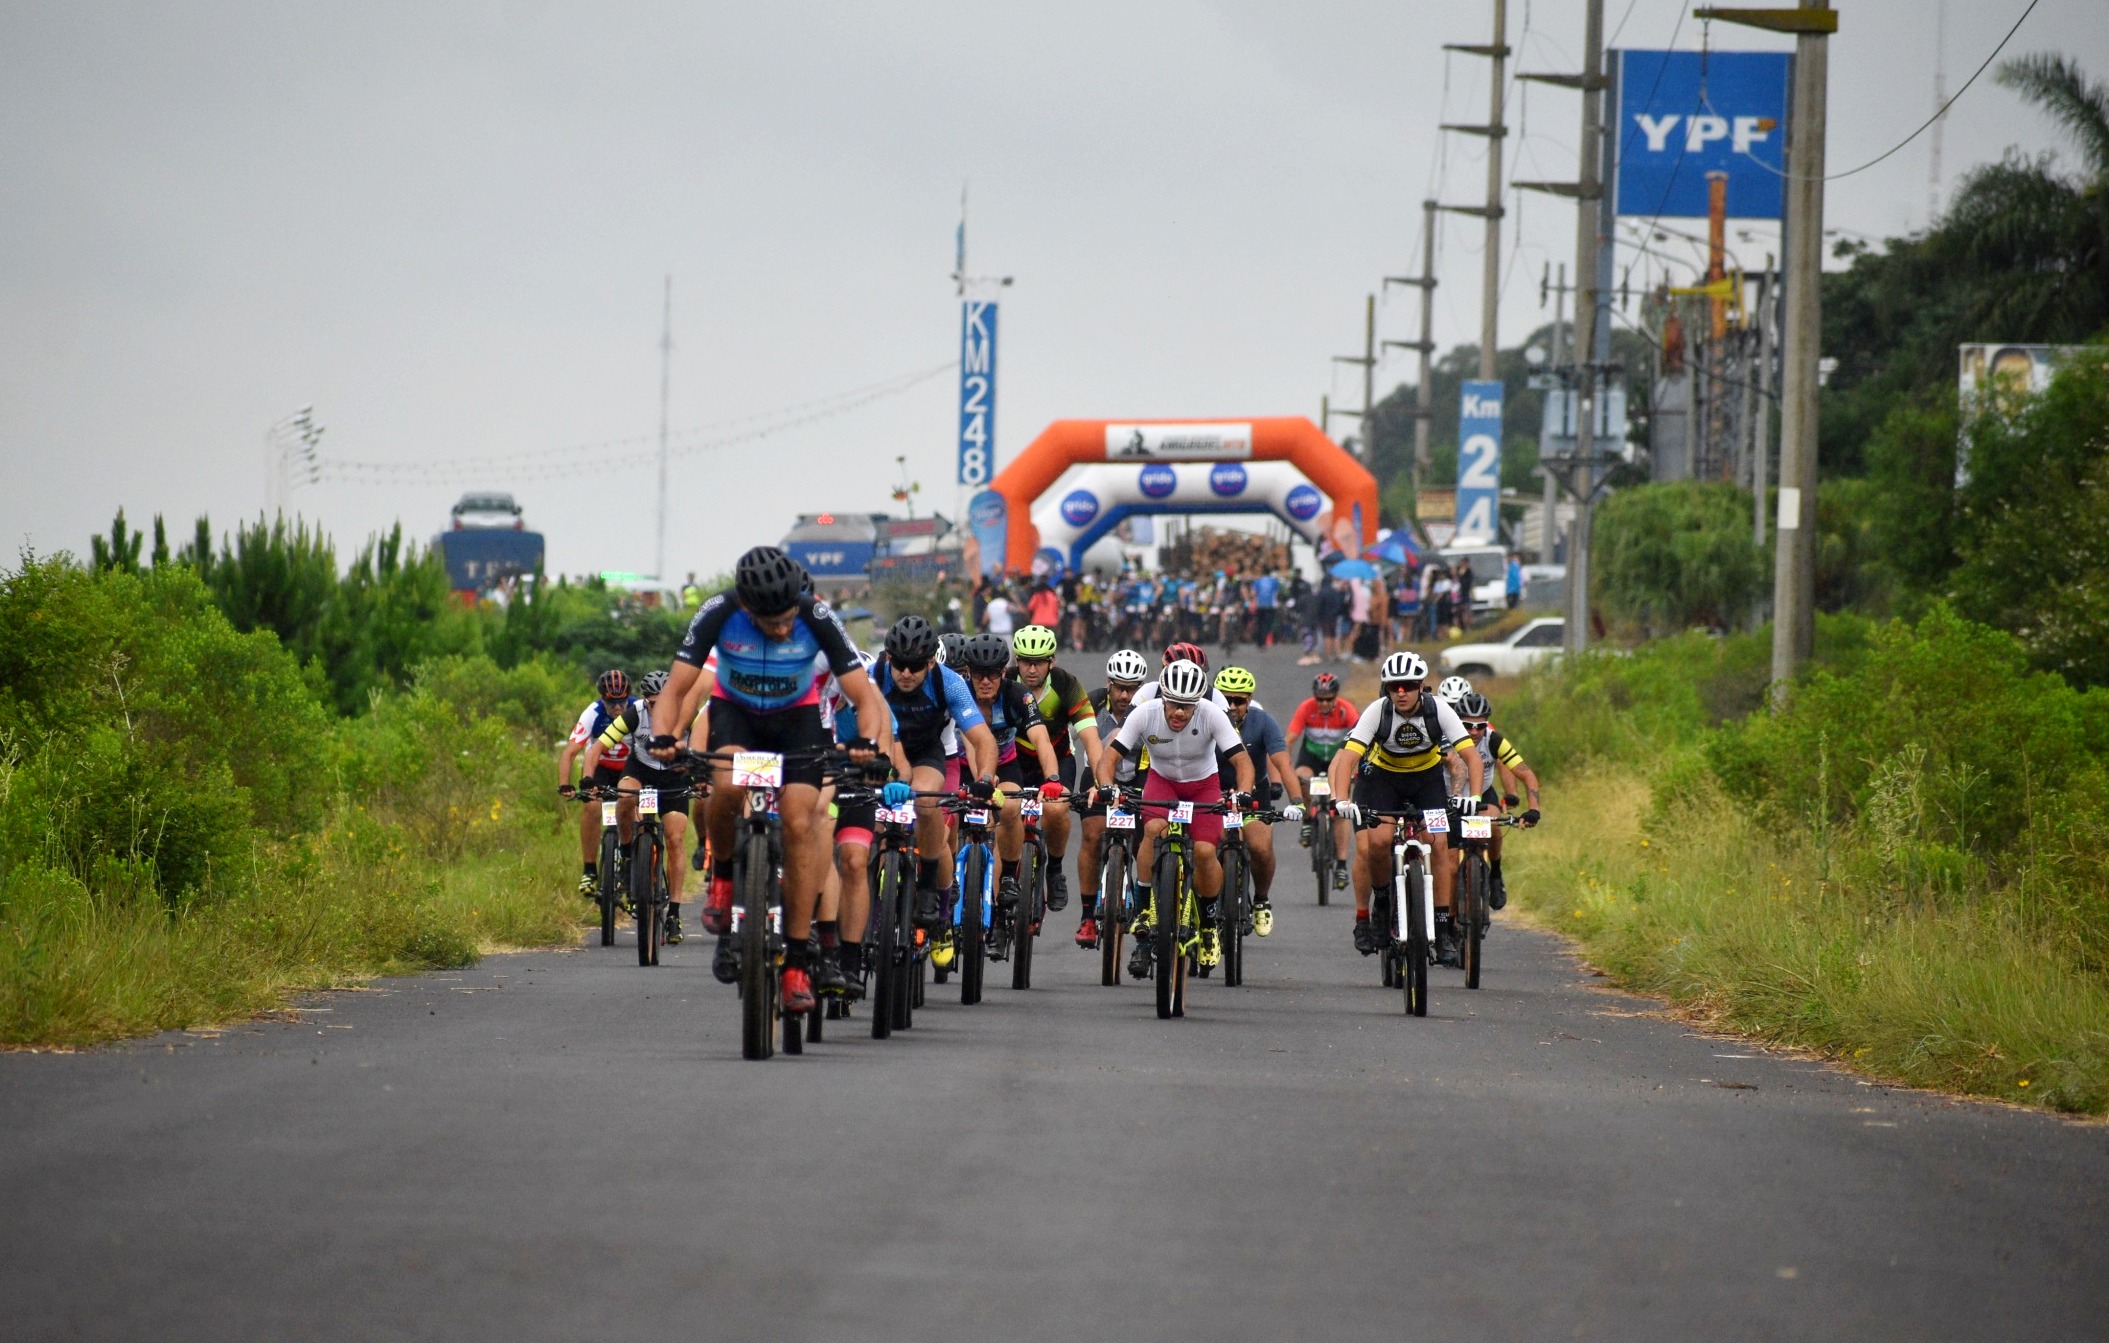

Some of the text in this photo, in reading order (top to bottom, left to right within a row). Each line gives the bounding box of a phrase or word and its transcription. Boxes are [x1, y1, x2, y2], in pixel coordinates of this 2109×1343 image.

[1633, 114, 1771, 152] YPF
[1463, 395, 1501, 417] Km
[805, 552, 844, 565] YPF
[739, 773, 775, 785] 234
[640, 797, 656, 808] 236
[1172, 809, 1189, 819] 231
[1110, 817, 1134, 826] 227
[1428, 817, 1447, 828] 226
[1466, 830, 1488, 838] 236
